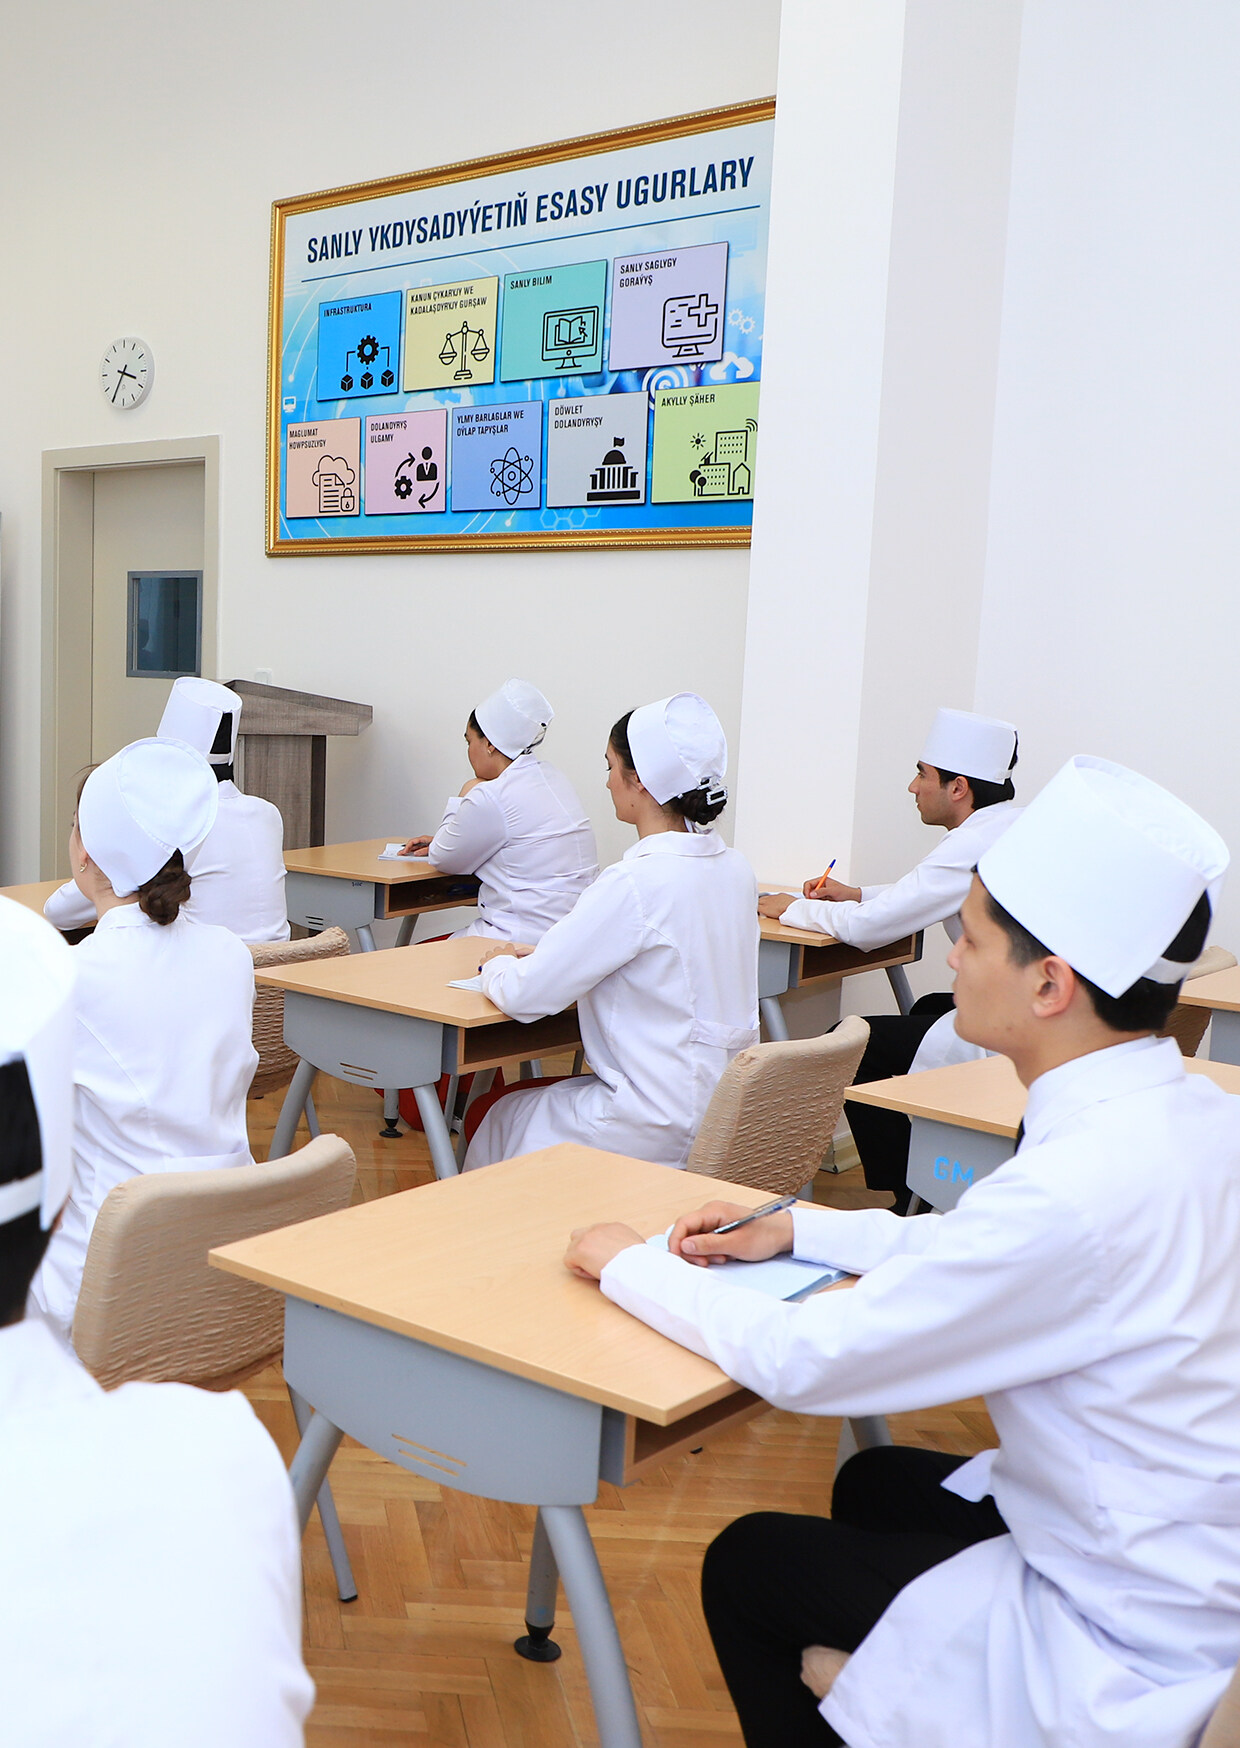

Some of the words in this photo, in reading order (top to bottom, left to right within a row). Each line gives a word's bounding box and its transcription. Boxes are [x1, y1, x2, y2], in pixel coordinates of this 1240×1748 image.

[307, 229, 363, 263] SANLY
[369, 191, 529, 252] YKDYSADYÝETIŇ
[536, 183, 609, 223] ESASY
[616, 156, 754, 209] UGURLARY
[620, 263, 643, 274] SANLY
[644, 258, 677, 271] SAGLYGY
[510, 279, 531, 290] SANLY
[532, 276, 552, 286] BILIM
[620, 274, 653, 288] GORAÝYŞ
[410, 292, 432, 304] KANUN
[464, 286, 474, 295] WE
[324, 302, 372, 317] INFRASTRUKTURA
[662, 396, 688, 407] AKYLLY
[690, 392, 716, 406] ŞÄHER
[457, 415, 474, 424] YLMY
[475, 411, 512, 422] BARLAGLAR
[514, 410, 524, 419] WE
[554, 404, 583, 416] DÖWLET
[290, 428, 318, 438] MAGLUMAT
[478, 424, 508, 435] TAPYŞLAR
[370, 434, 394, 444] ULGAMY
